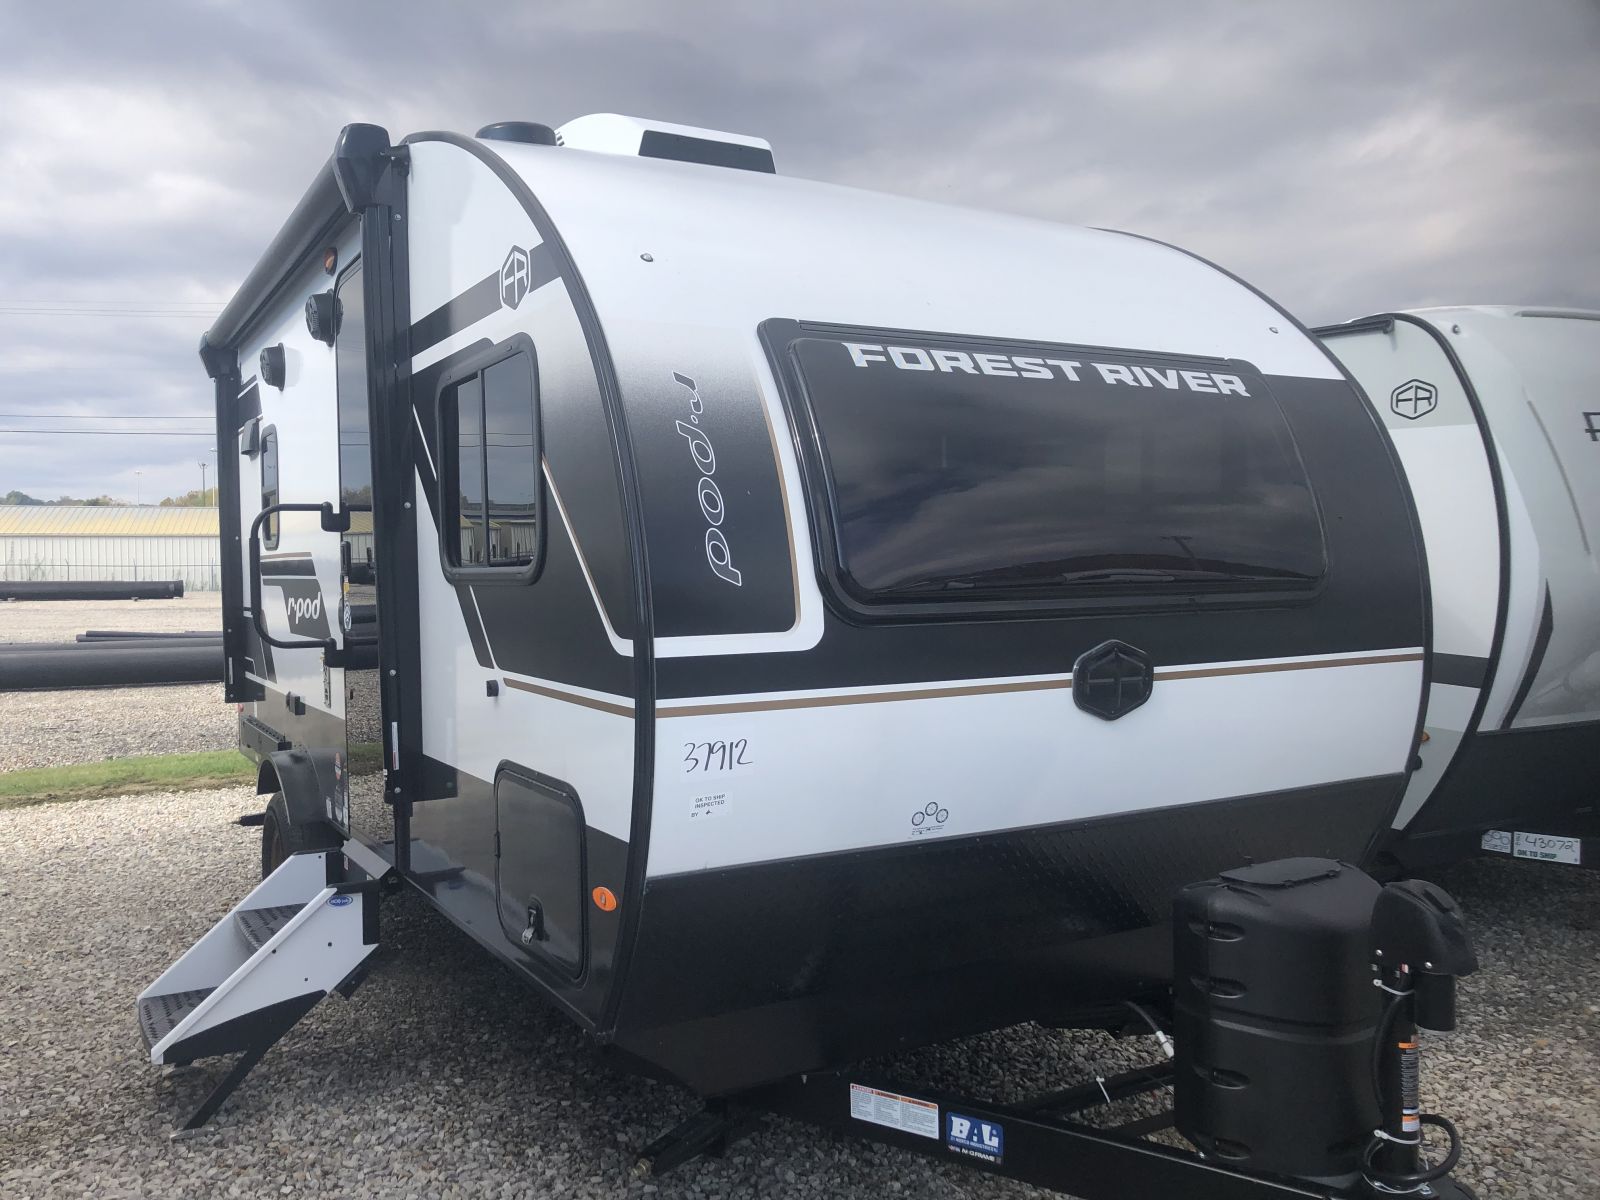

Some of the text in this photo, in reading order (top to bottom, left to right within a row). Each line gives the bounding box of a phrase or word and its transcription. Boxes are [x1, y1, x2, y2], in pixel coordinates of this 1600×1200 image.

[841, 342, 1251, 397] FOREST RIVER
[683, 738, 753, 773] 37912
[694, 799, 725, 809] INSPECTED
[1525, 835, 1573, 851] 43072
[1528, 850, 1538, 858] TO
[1539, 851, 1557, 859] SHIP
